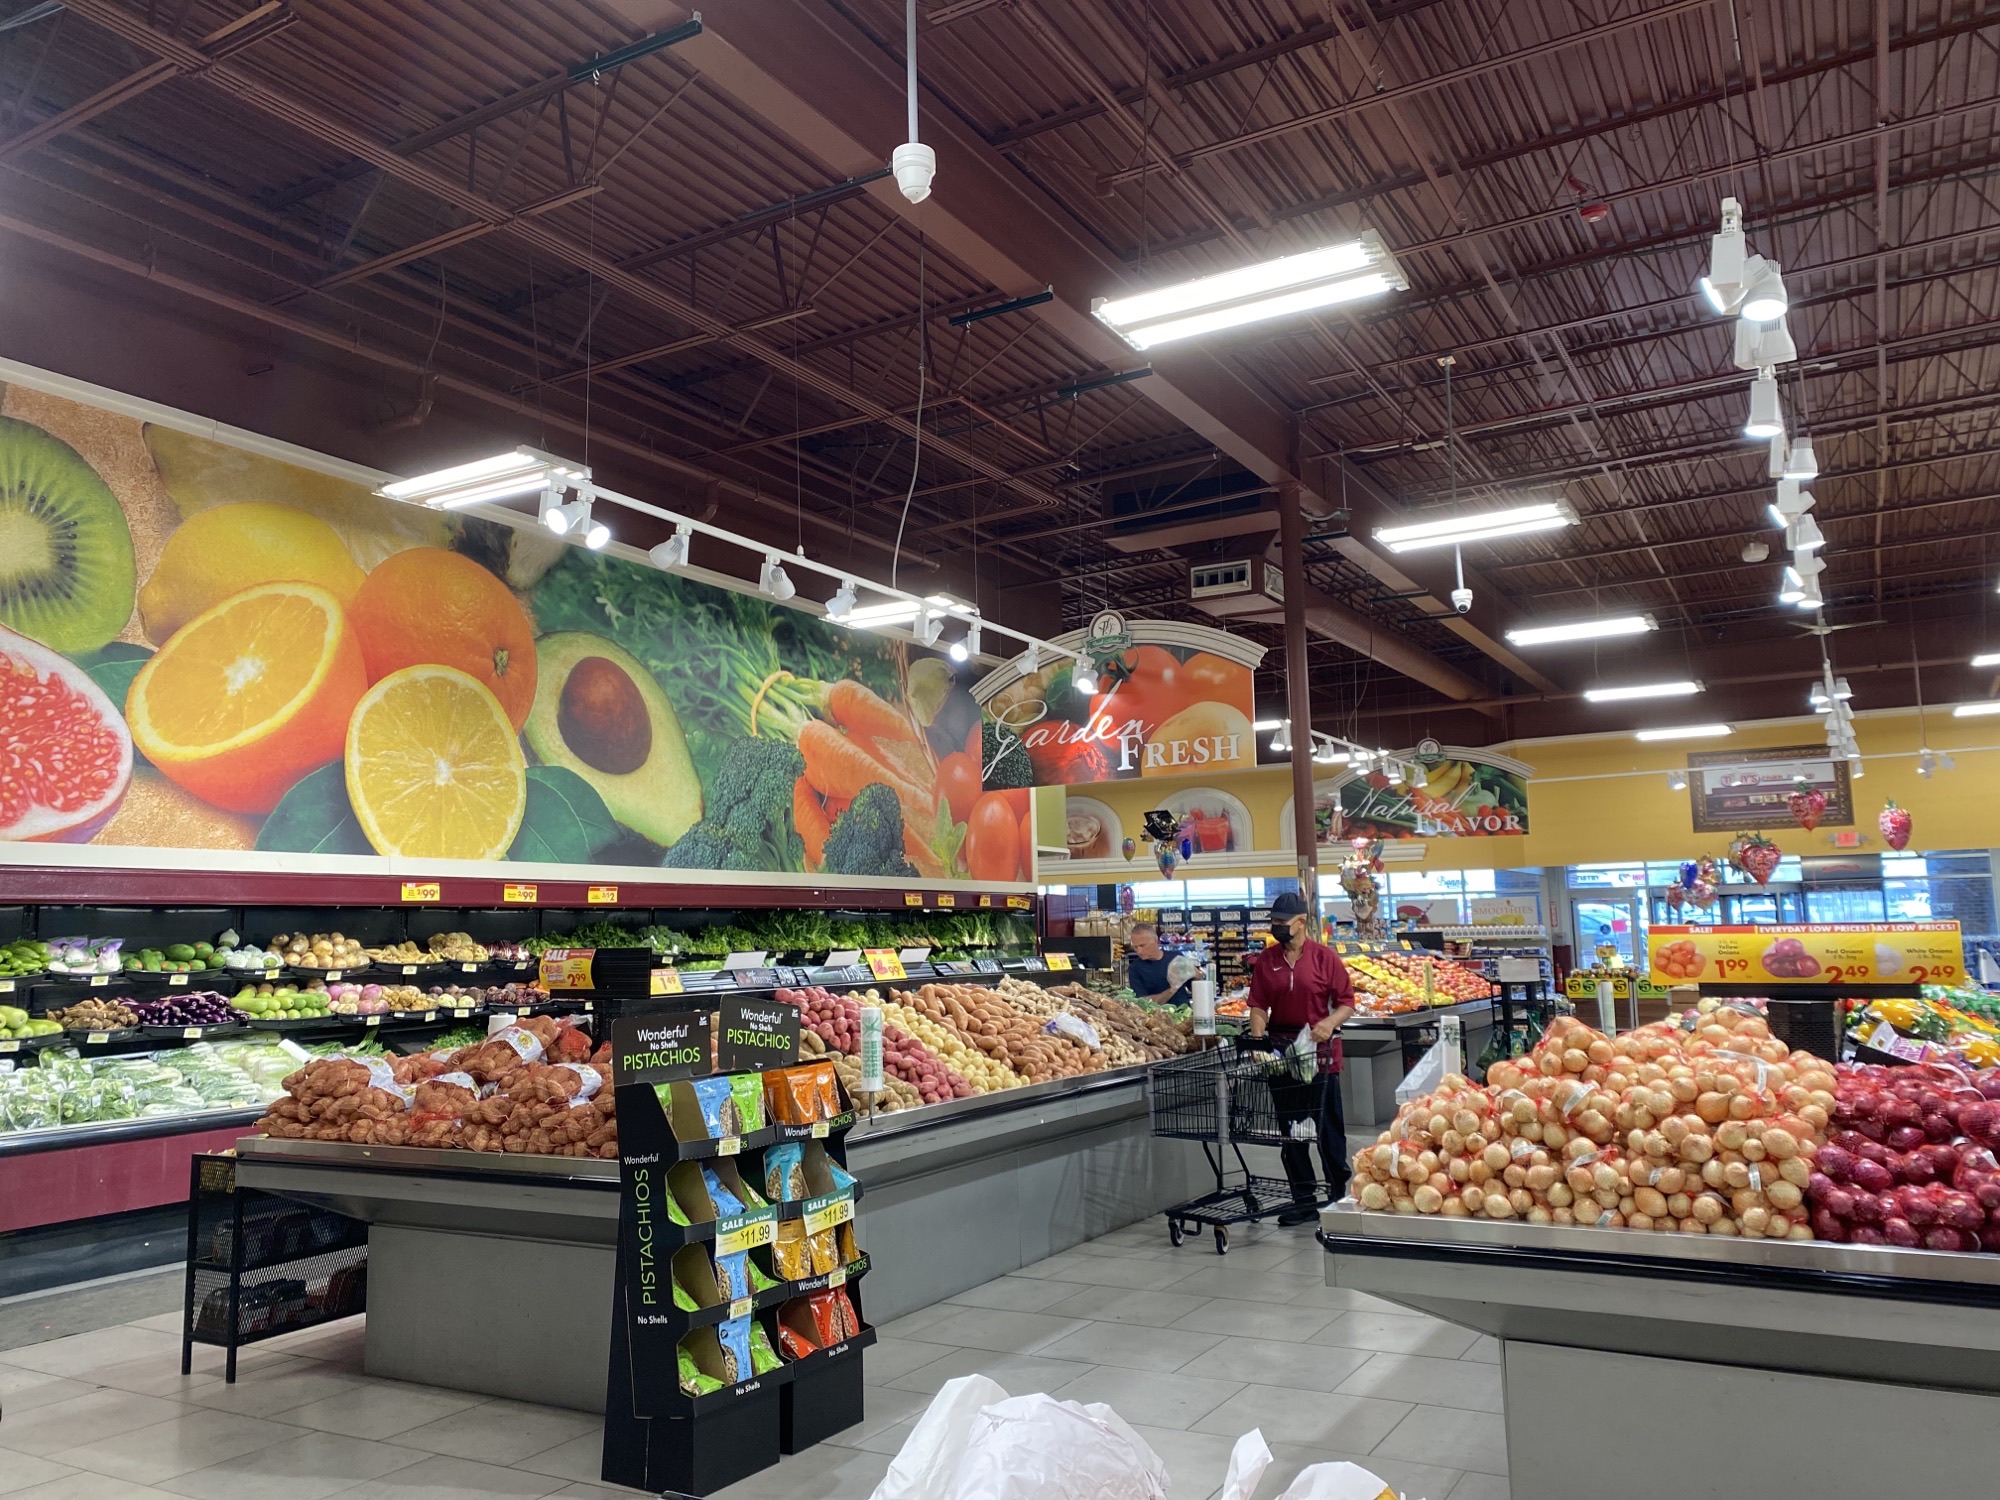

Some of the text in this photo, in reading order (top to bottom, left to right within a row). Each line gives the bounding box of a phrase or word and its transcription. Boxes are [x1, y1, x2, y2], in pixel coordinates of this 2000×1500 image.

[982, 679, 1154, 782] Garden
[1117, 734, 1241, 771] FRESH
[1342, 781, 1478, 820] Natural
[1415, 812, 1522, 834] FLAVOR
[1473, 905, 1534, 915] SMOOTHIES
[1689, 926, 1713, 934] SALE!
[1759, 924, 1870, 934] EVERYDAY LOW PRICES!
[1891, 924, 1916, 932] LOW
[1919, 923, 1956, 932] PRICES!
[544, 950, 568, 961] SALE
[740, 1007, 783, 1025] Wonderful
[637, 1024, 689, 1042] Wonderful
[749, 1022, 773, 1032] No Shells
[650, 1041, 678, 1050] No Shells
[726, 1028, 791, 1050] PISTACHIOS
[623, 1047, 700, 1071] PISTACHIOS
[785, 1113, 852, 1137] Wonderf ACHIOS
[624, 1153, 659, 1165] Wonderful
[807, 1199, 826, 1212] SALE
[823, 1203, 849, 1224] $11.99
[721, 1218, 743, 1232] SALE
[745, 1216, 758, 1225] Fresh
[635, 1169, 657, 1305] PISTACHIOS
[740, 1224, 770, 1245] $11.99
[798, 1276, 828, 1291] Wonderfu
[637, 1315, 668, 1325] No Shells
[828, 1343, 849, 1357] No Shells
[735, 1381, 760, 1396] No Shells
